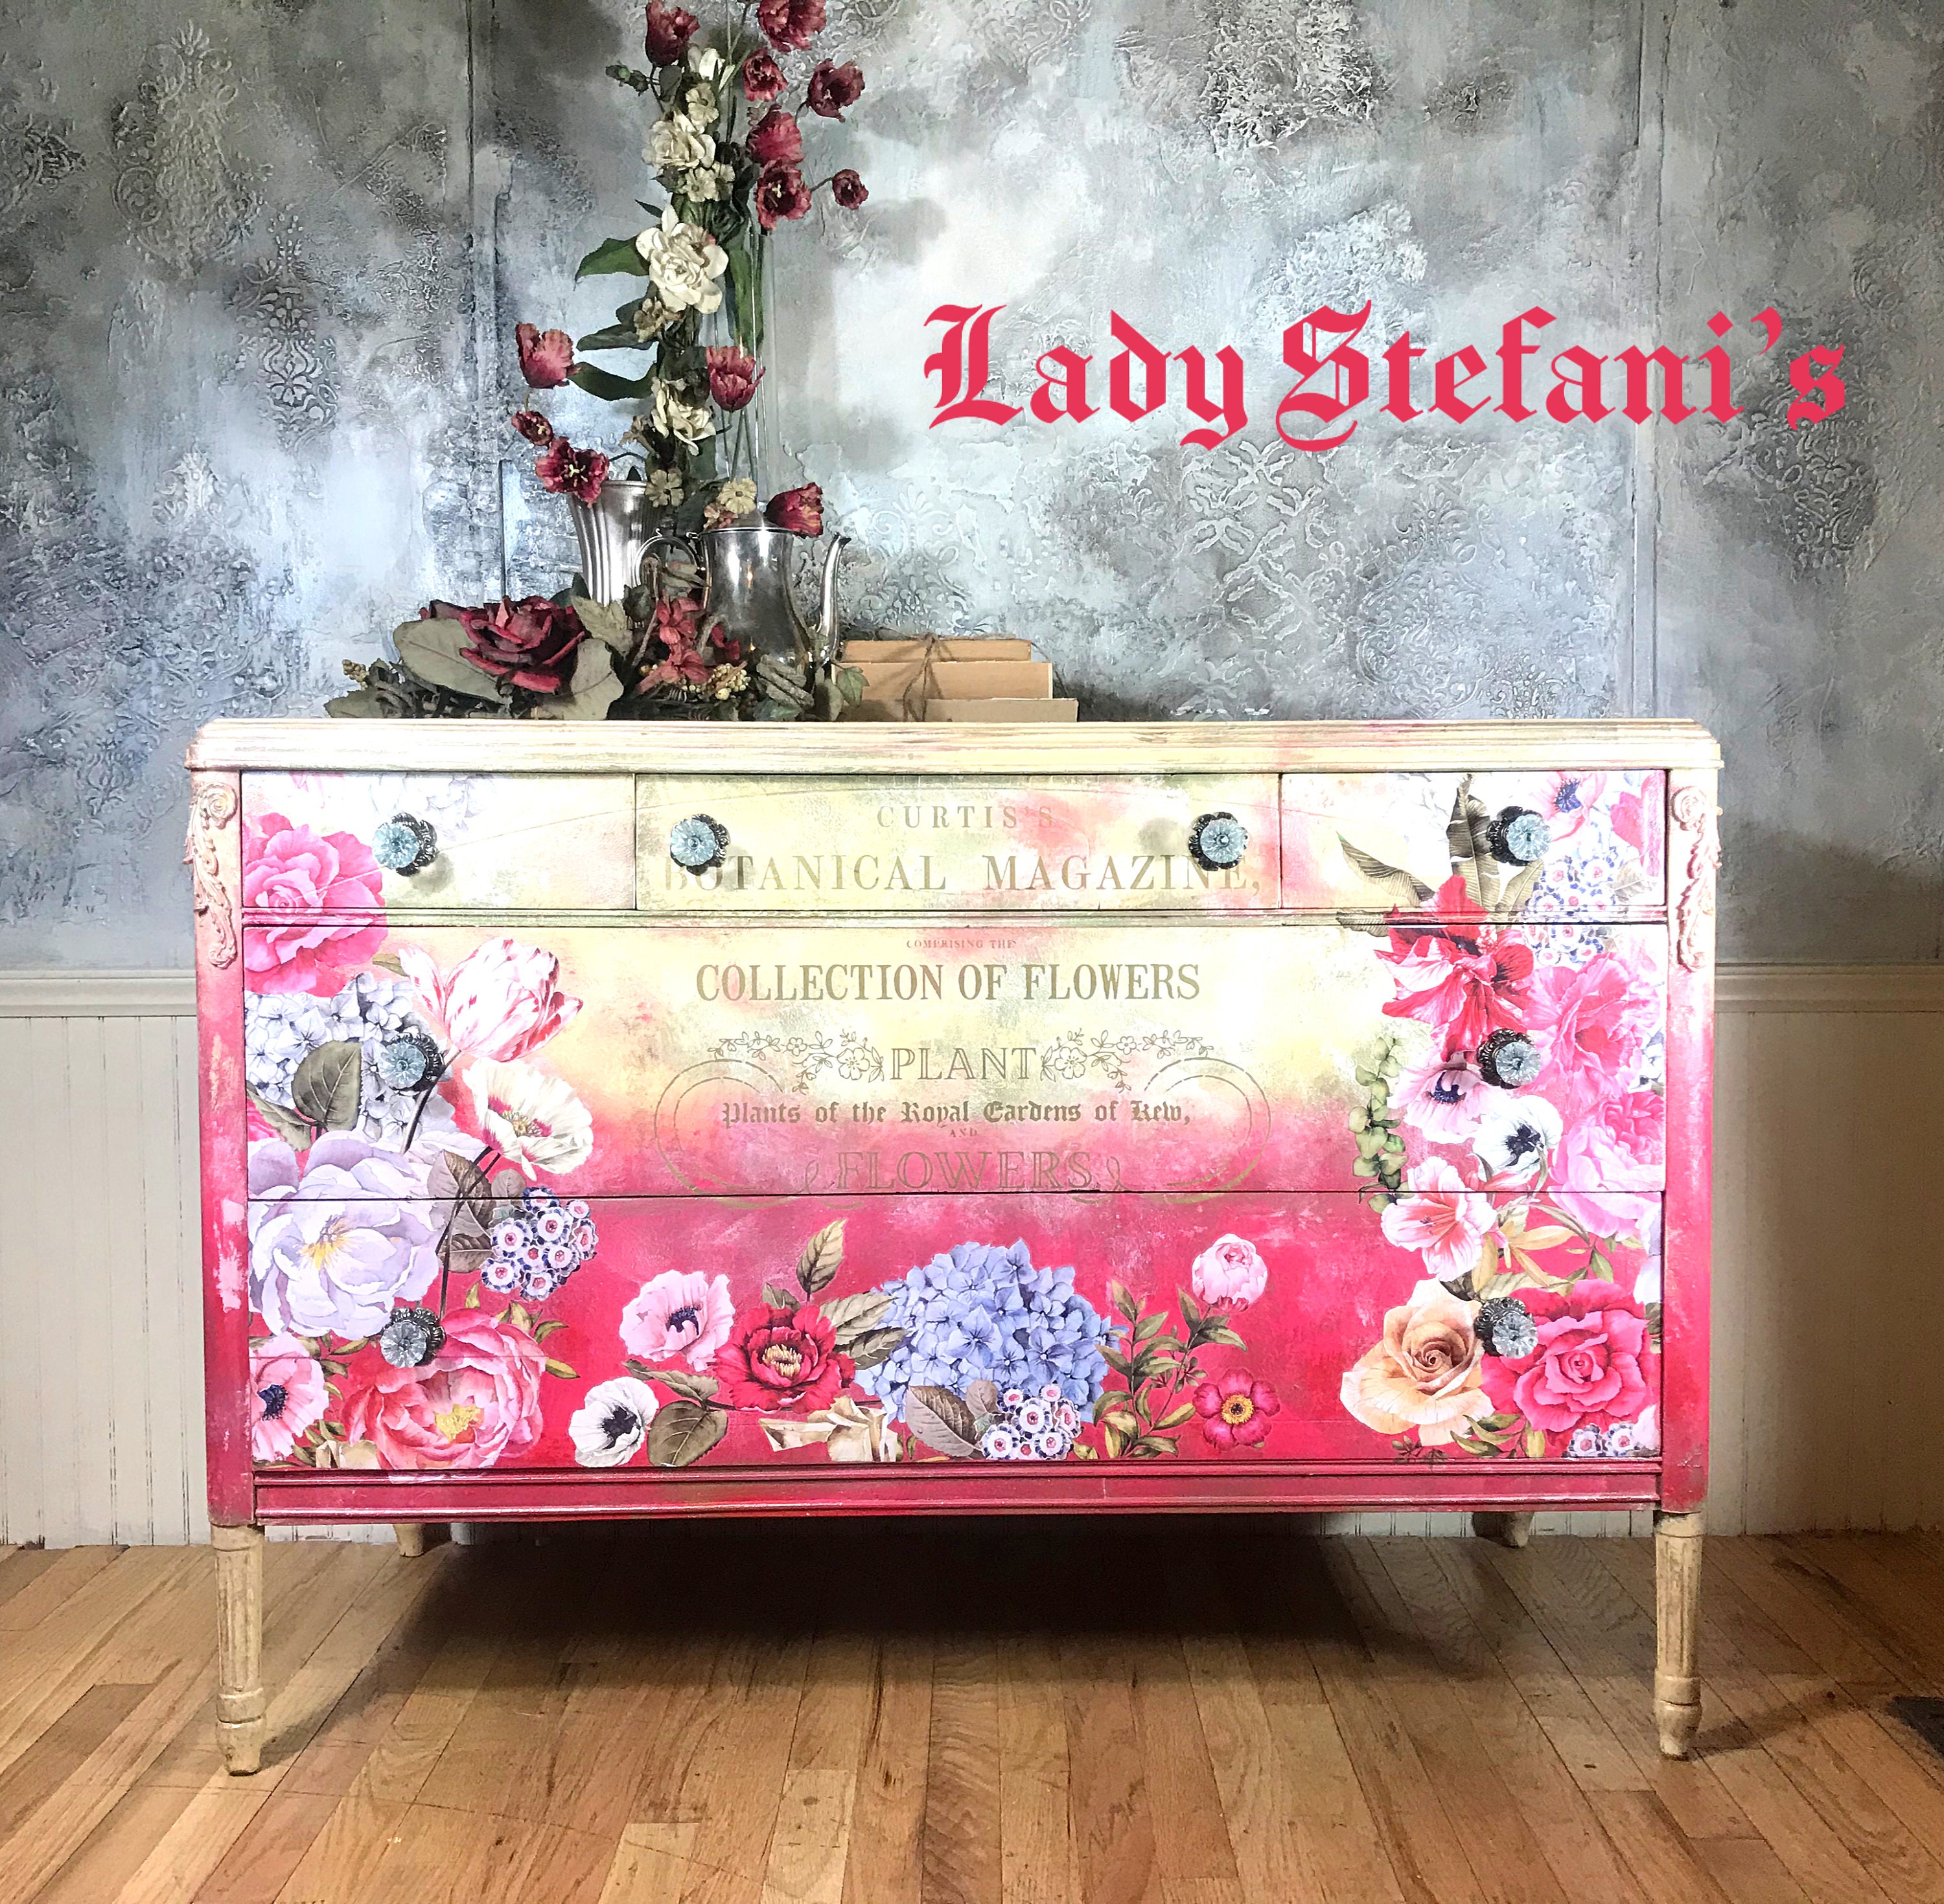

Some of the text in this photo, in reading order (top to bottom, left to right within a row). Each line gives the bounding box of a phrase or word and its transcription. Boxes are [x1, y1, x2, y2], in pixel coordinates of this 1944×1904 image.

[877, 805, 1053, 829] CURTIS'S
[696, 963, 1200, 1001] COLLECTION OF FLOWERS
[890, 1047, 1037, 1080] PLANT
[722, 1101, 801, 1129] Plants
[815, 1101, 839, 1123] of
[852, 1101, 886, 1124] the
[901, 1100, 969, 1128] Royal
[1094, 1101, 1119, 1122] of
[1130, 1100, 1191, 1125] Kew,
[949, 1128, 977, 1138] AND
[836, 1151, 1093, 1189] FLOWERS
